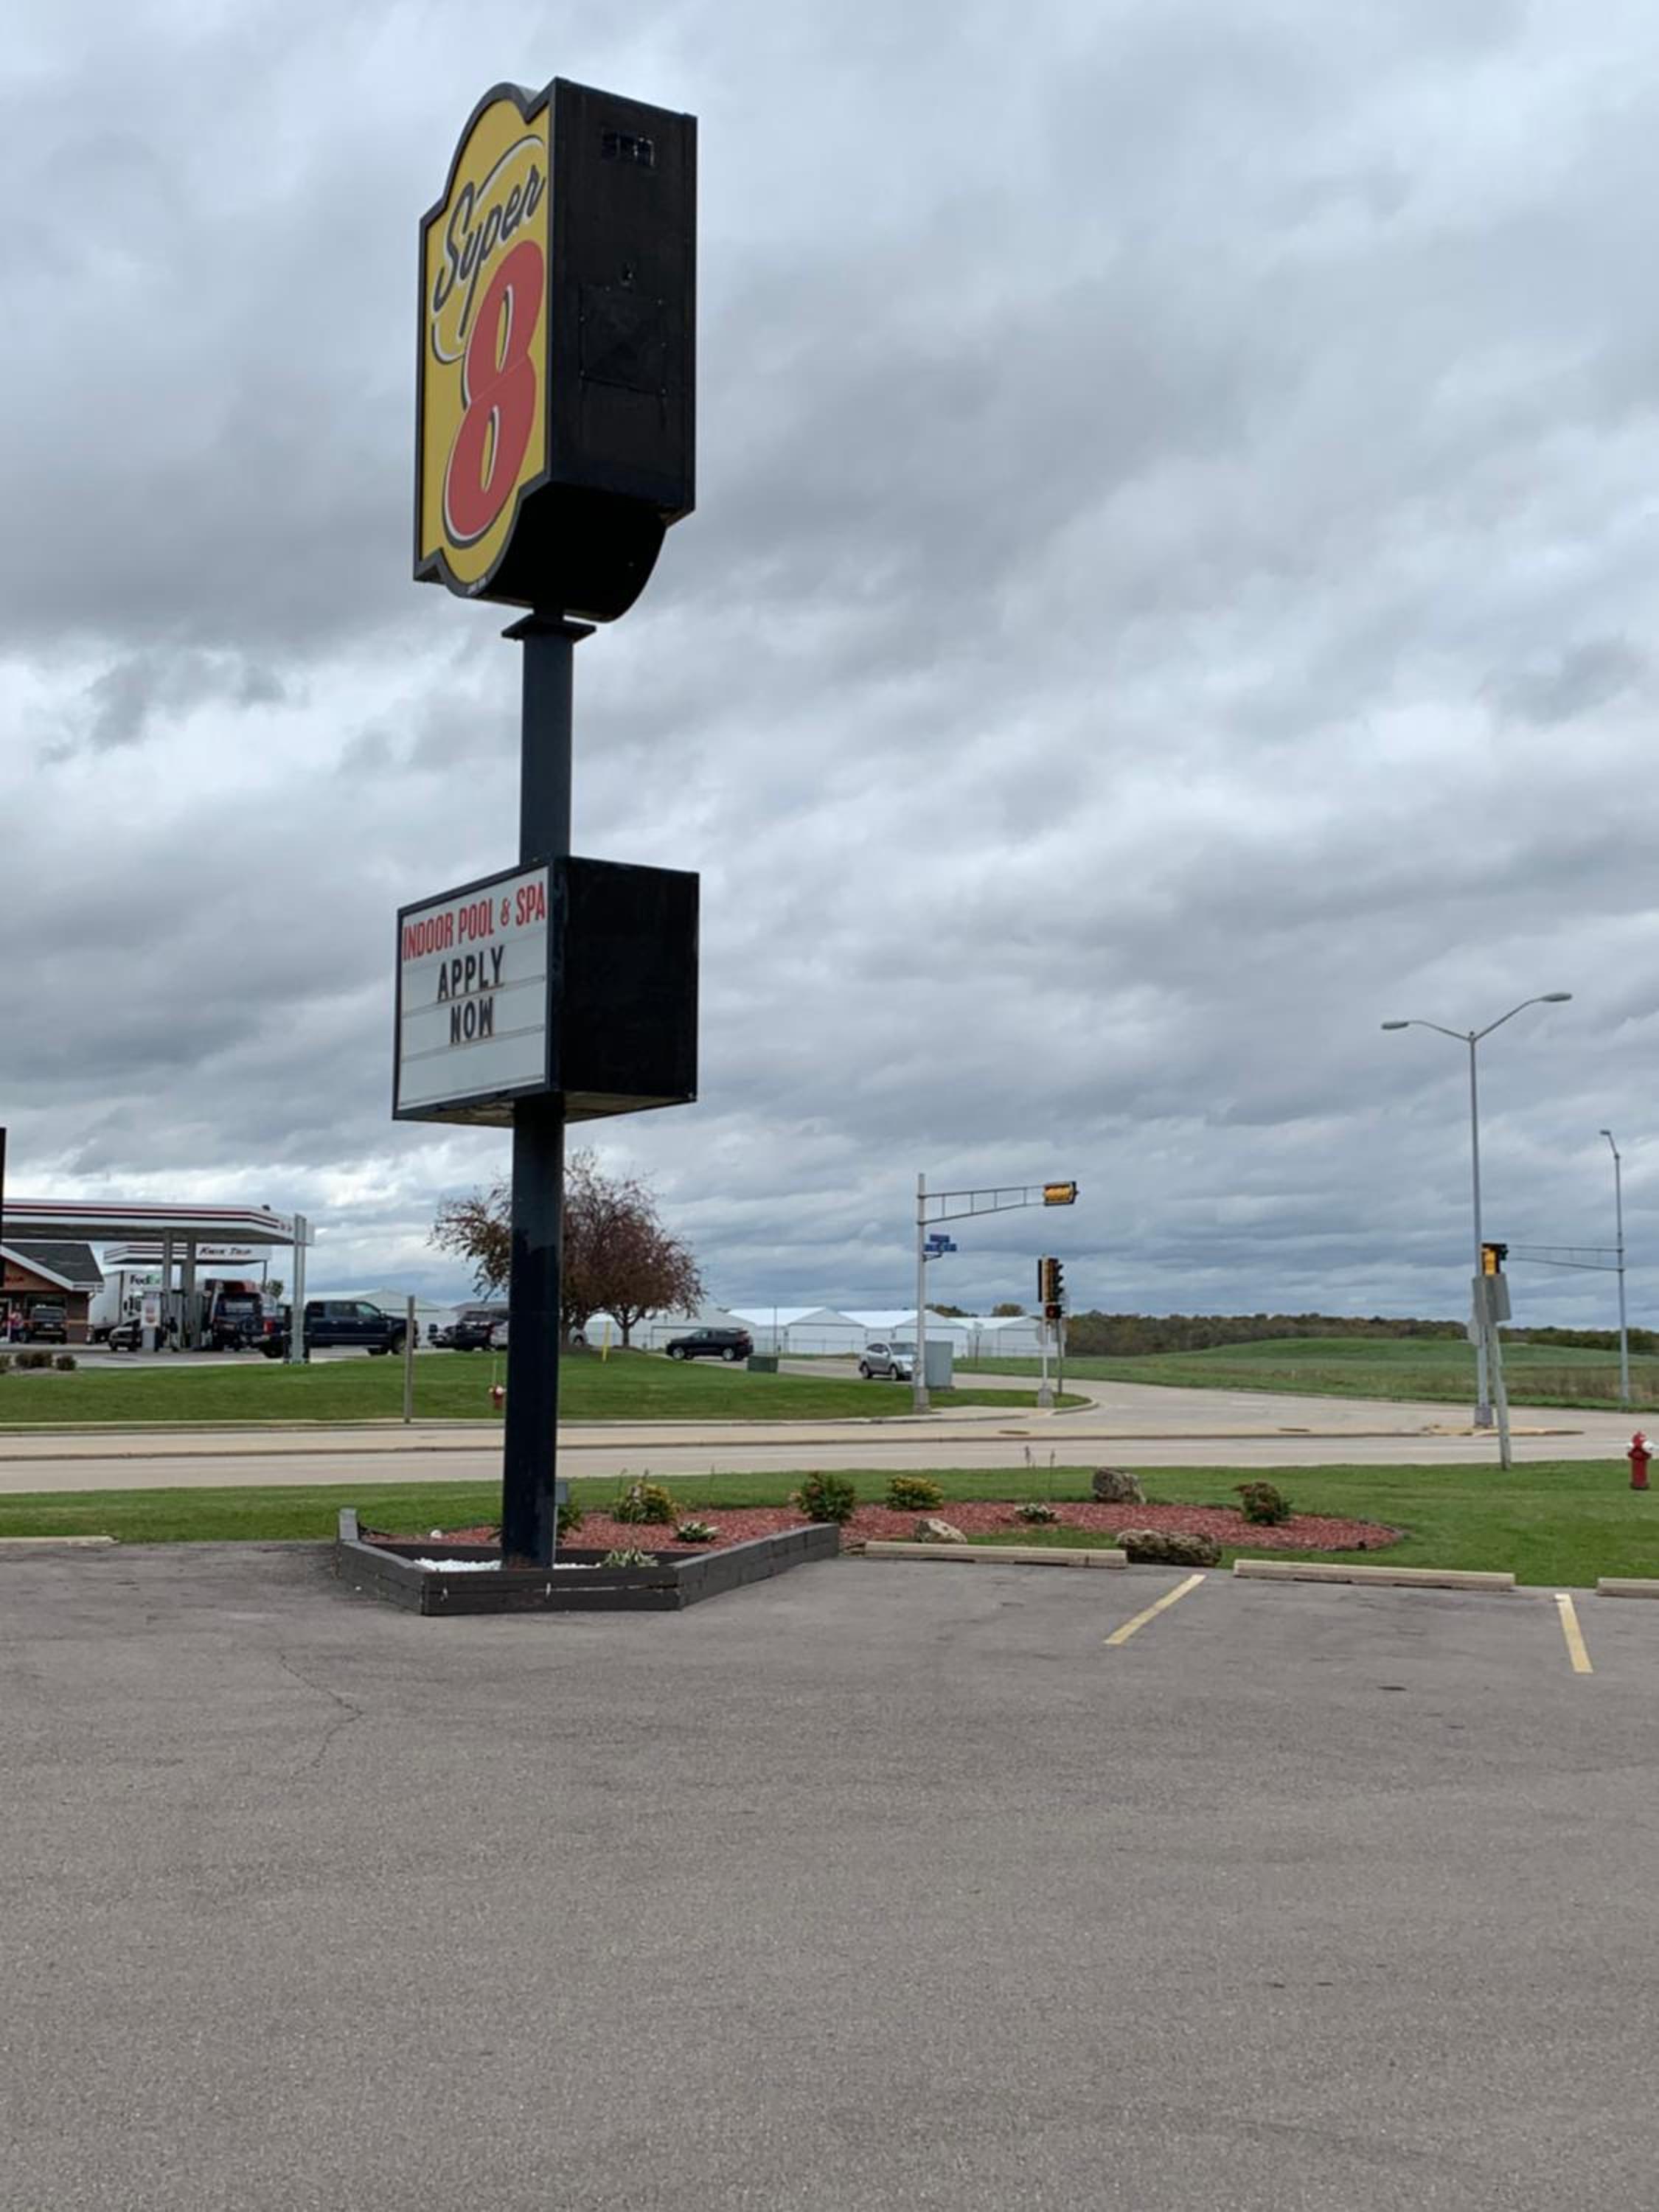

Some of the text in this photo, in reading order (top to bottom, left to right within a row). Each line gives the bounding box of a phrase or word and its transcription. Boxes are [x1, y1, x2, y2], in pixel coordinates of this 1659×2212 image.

[432, 164, 546, 339] Super
[444, 240, 544, 546] 8
[402, 883, 545, 961] INDOOR POOL & SPA
[438, 945, 504, 1003] APPLY
[451, 996, 493, 1044] NOW
